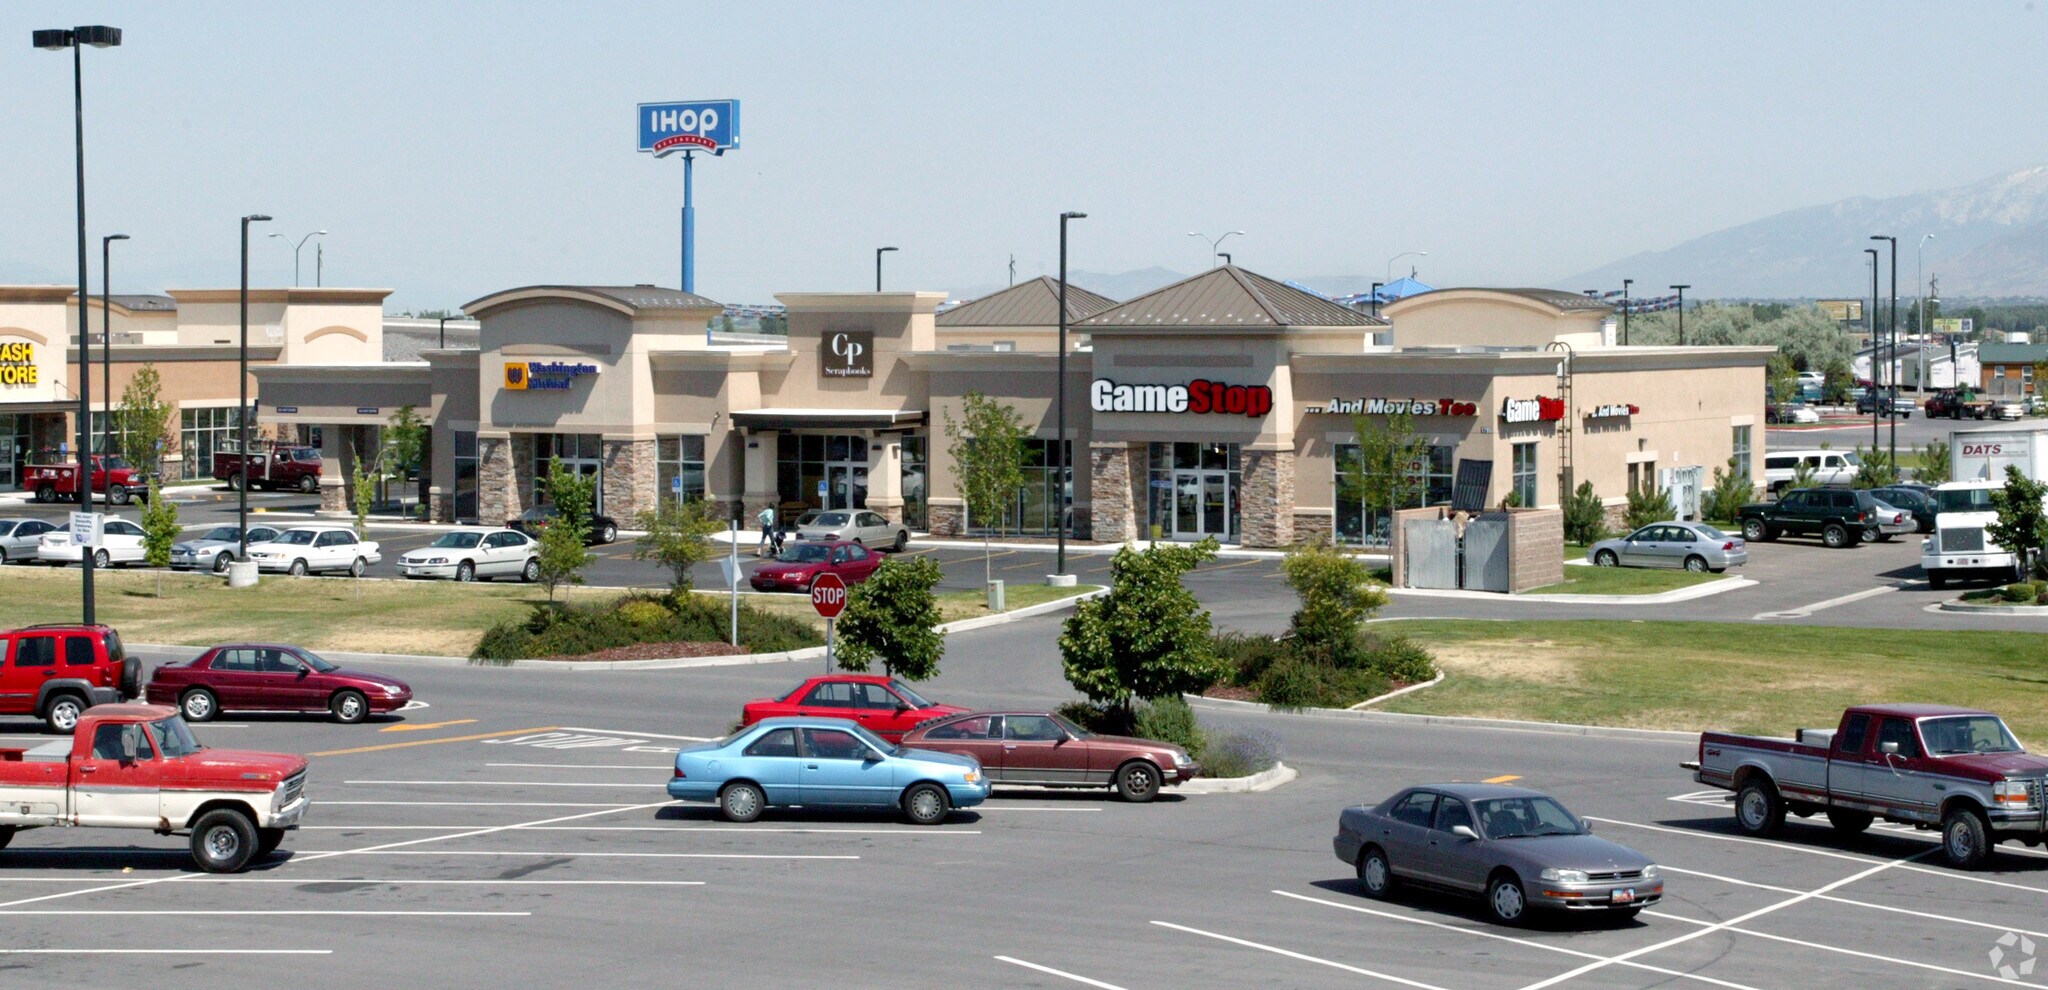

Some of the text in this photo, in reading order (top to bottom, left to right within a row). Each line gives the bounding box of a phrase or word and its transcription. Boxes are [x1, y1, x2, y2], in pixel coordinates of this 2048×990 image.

[651, 108, 718, 138] IHOP
[0, 343, 33, 361] ASH
[528, 362, 598, 377] Washington
[528, 378, 570, 390] Mutual
[1091, 379, 1272, 418] GameStop
[1327, 398, 1366, 414] And
[1367, 398, 1436, 415] Movies
[1439, 399, 1477, 416] Too
[1505, 396, 1565, 423] GameStop
[1963, 444, 2001, 455] DATS
[813, 587, 844, 605] STOP
